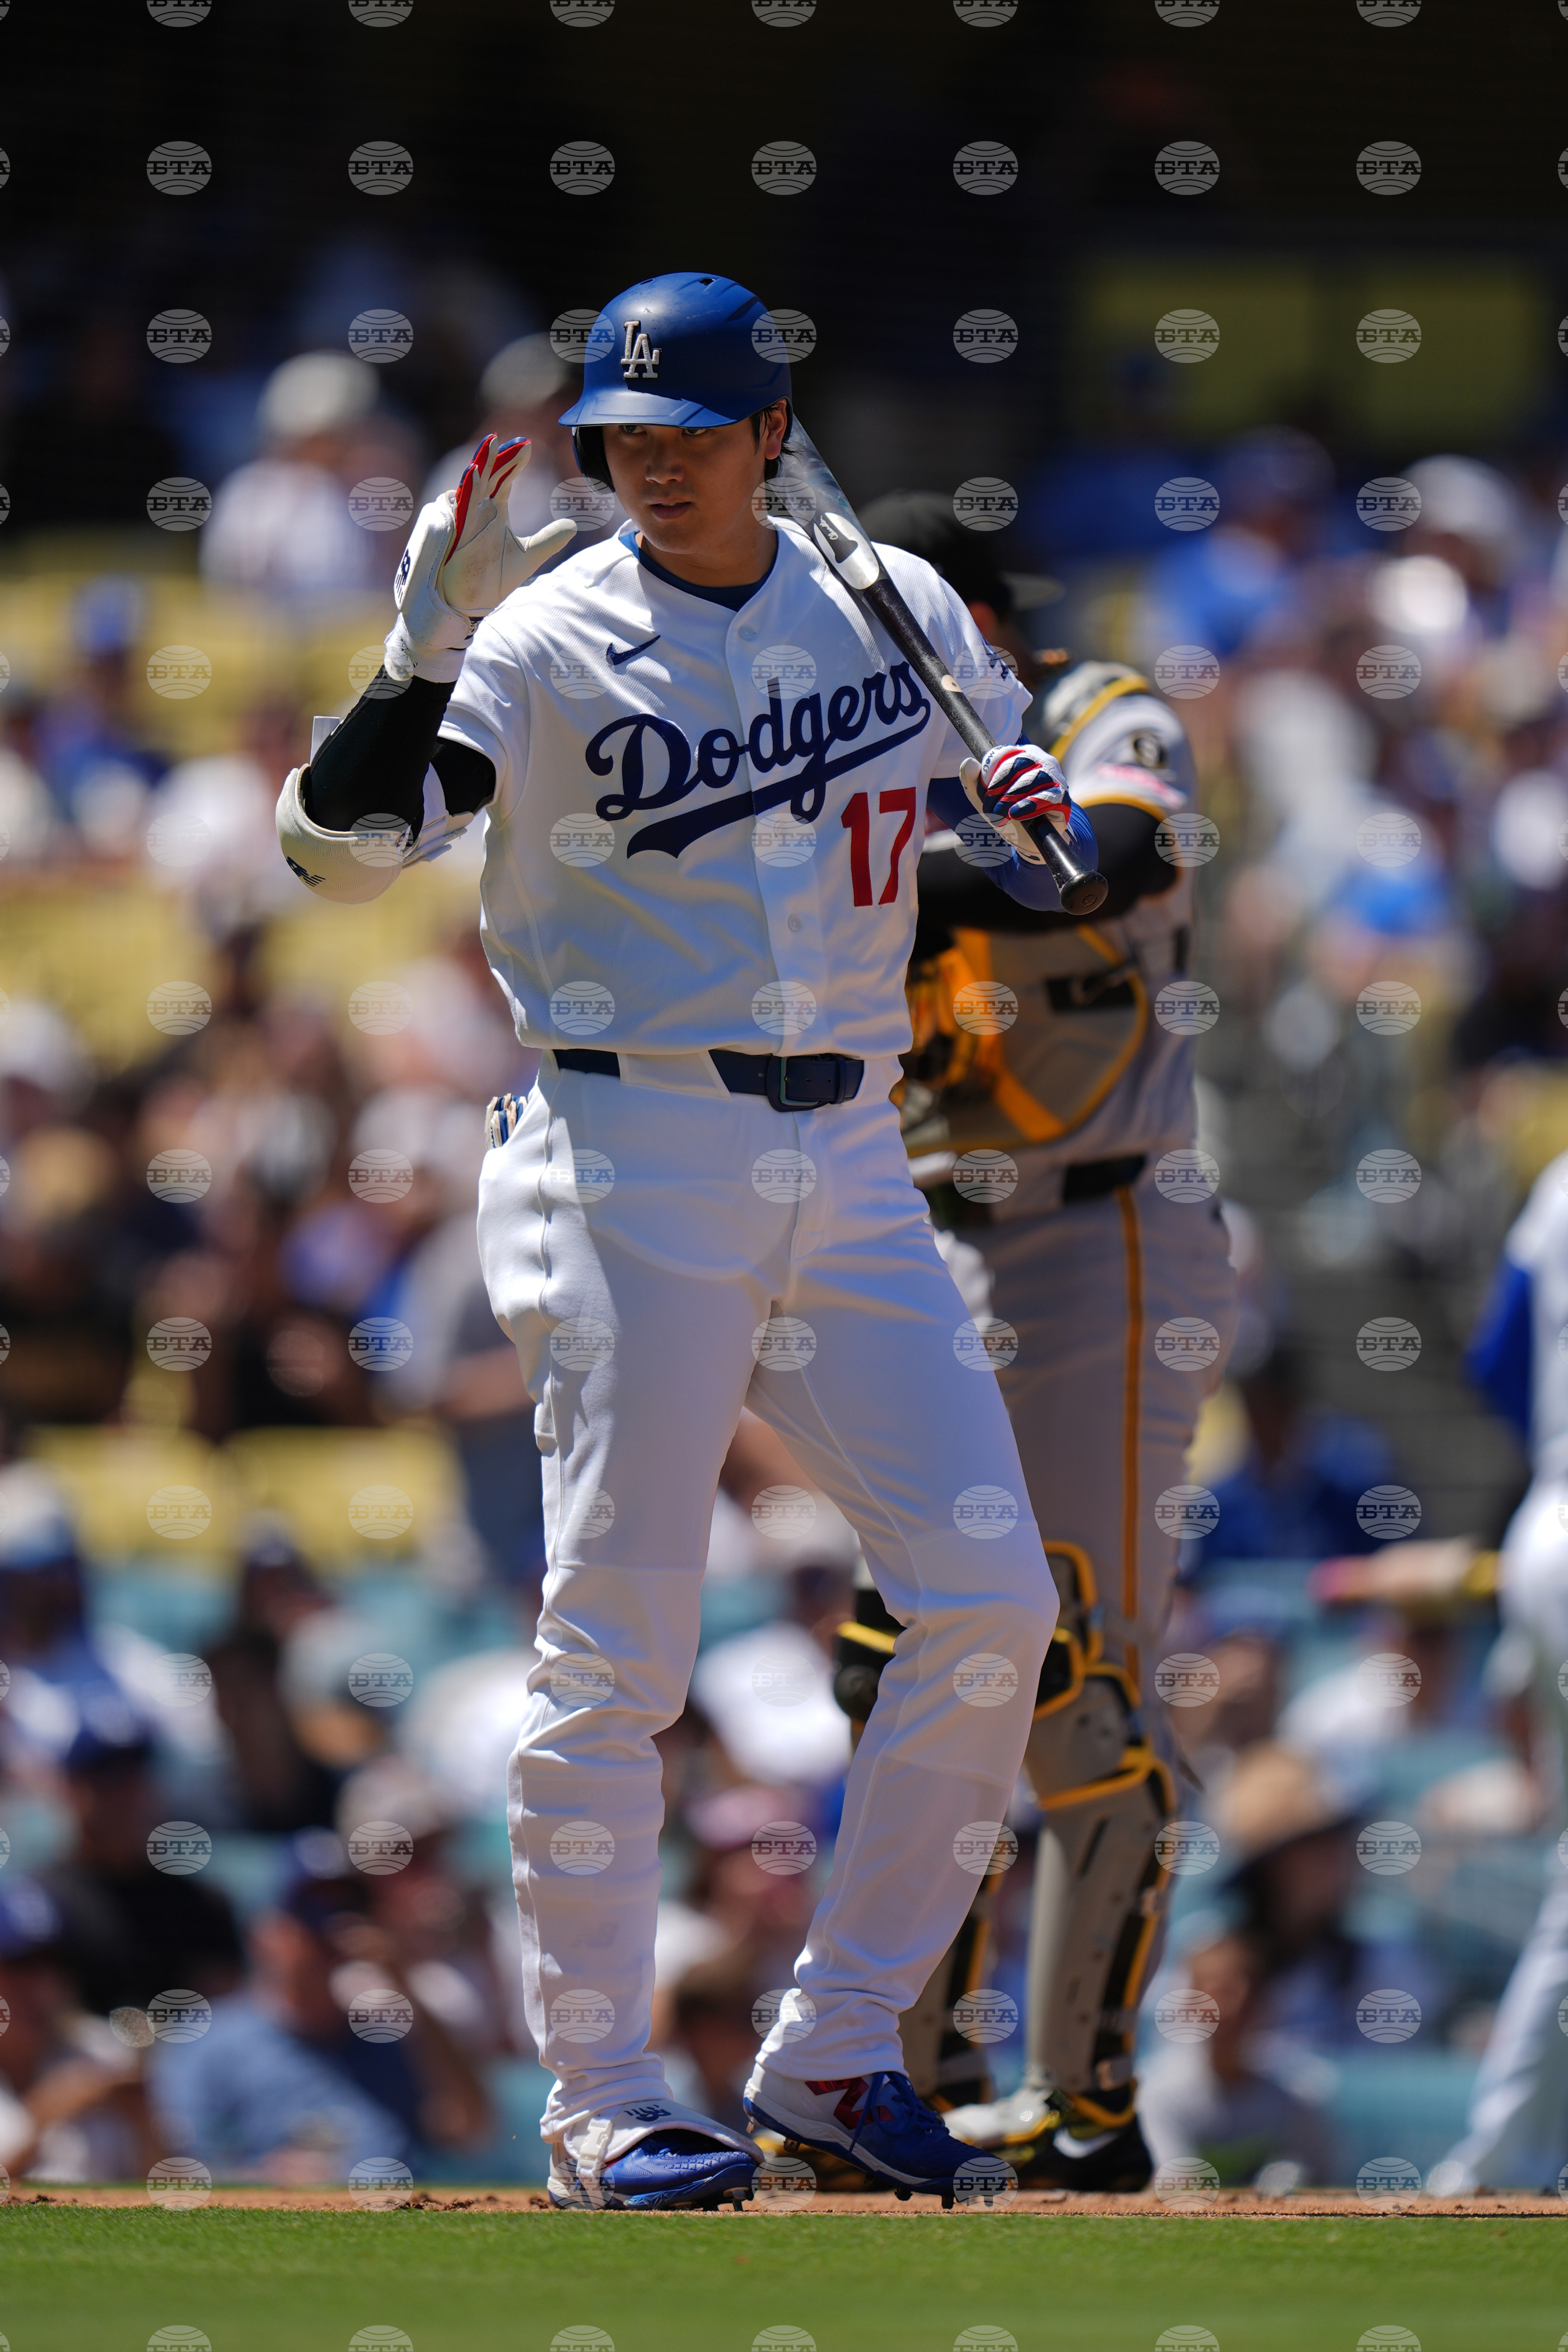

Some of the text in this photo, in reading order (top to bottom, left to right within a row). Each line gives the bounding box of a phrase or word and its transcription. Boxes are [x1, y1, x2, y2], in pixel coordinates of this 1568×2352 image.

[620, 320, 660, 378] LA
[585, 661, 931, 823] Dodgers
[842, 787, 916, 907] 17
